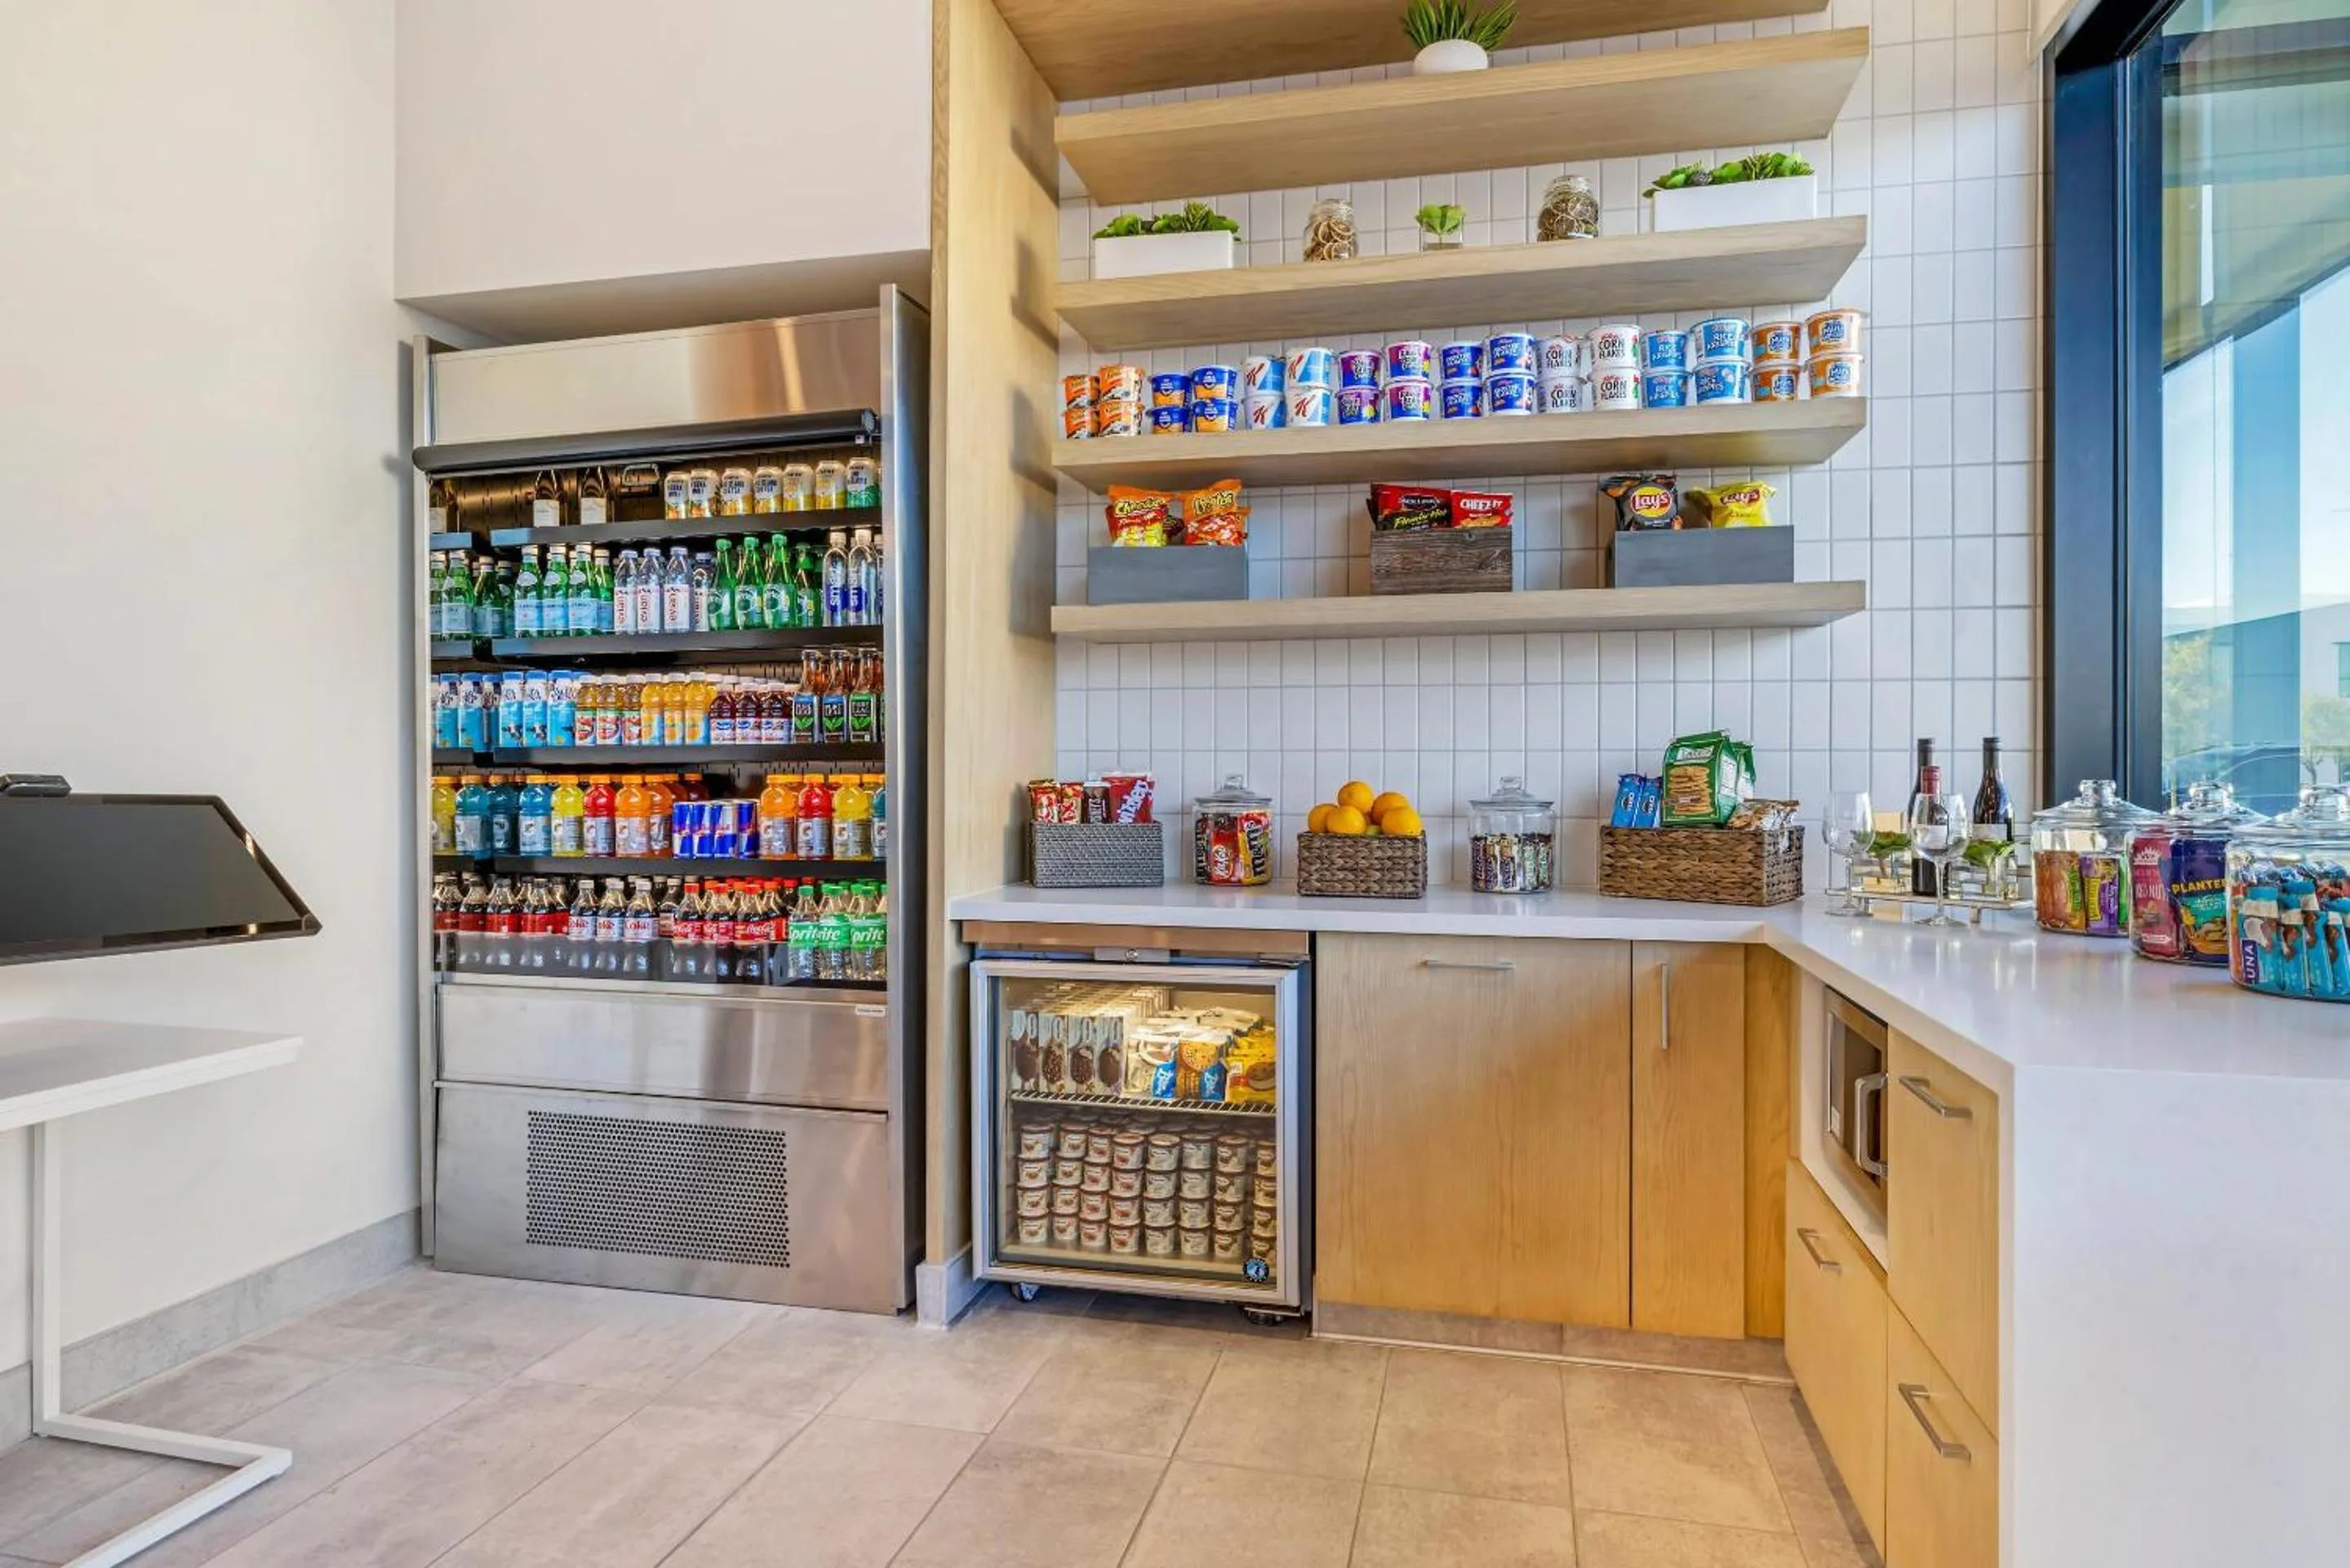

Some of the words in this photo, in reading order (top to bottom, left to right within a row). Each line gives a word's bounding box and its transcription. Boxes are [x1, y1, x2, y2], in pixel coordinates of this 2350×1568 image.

[1598, 339, 1625, 349] CORN
[1246, 362, 1264, 386] K
[1288, 353, 1304, 380] K
[1601, 380, 1627, 392] CORN
[1253, 405, 1268, 424] K
[1295, 393, 1316, 418] K
[2246, 945, 2256, 979] UNA
